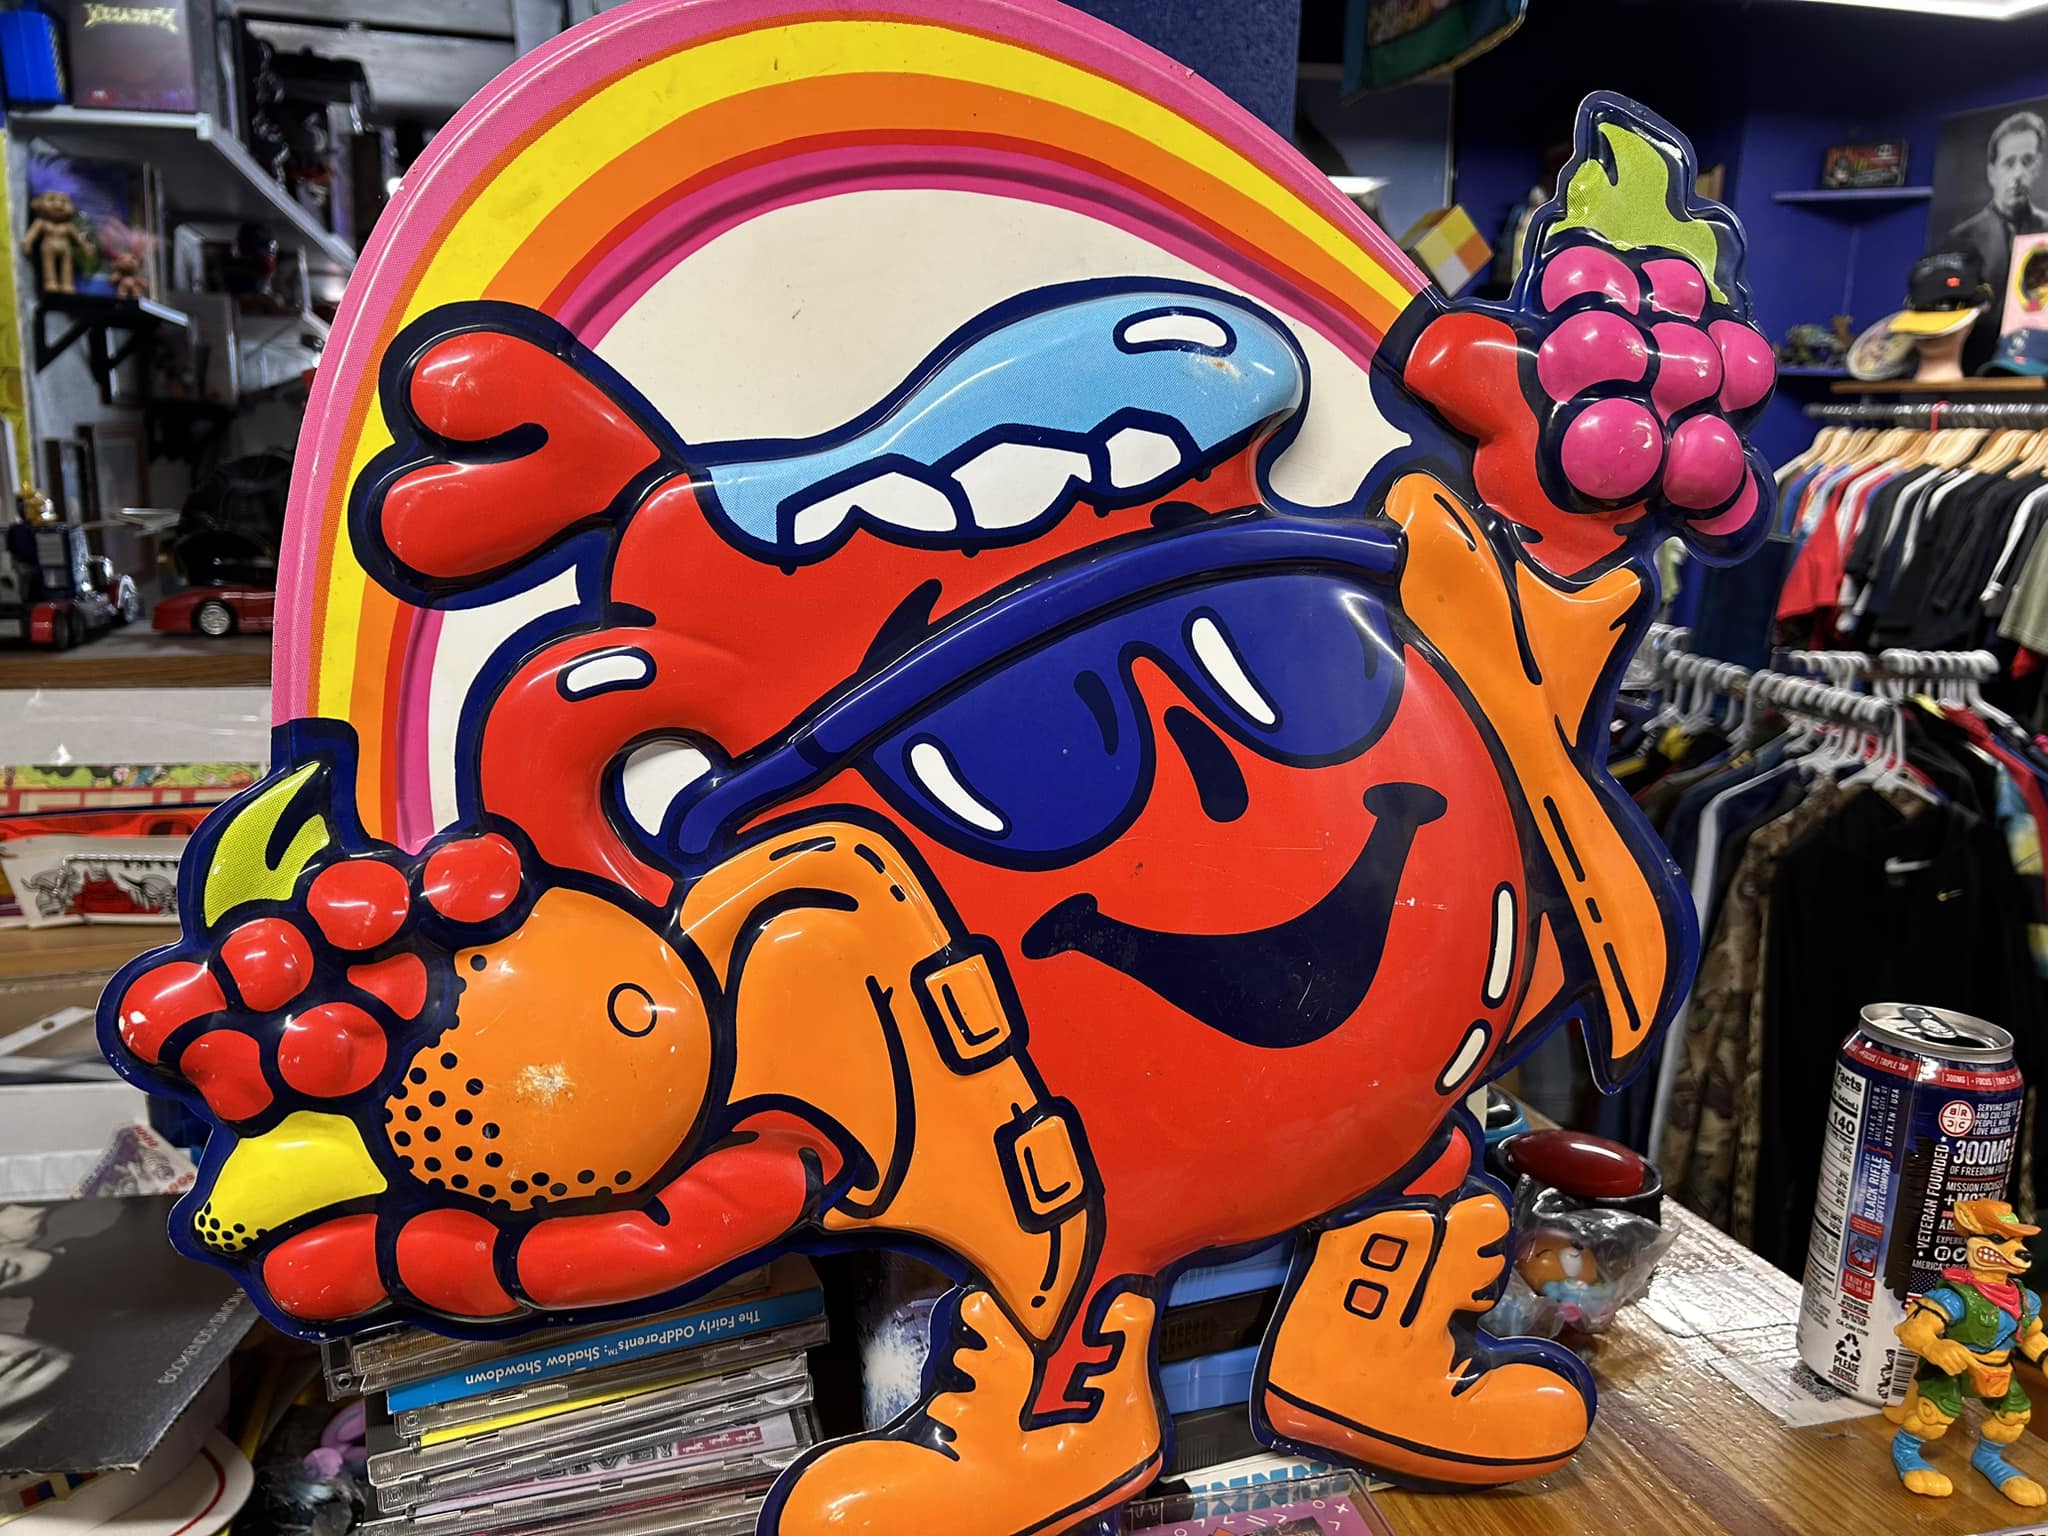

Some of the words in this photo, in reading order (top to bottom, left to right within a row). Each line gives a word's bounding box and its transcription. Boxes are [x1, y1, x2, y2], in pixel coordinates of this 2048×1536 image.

[1890, 1088, 1899, 1104] USA
[1833, 1111, 1856, 1135] 140
[1976, 1111, 1989, 1119] AND
[1973, 1127, 1988, 1135] LOVE
[1953, 1139, 2011, 1165] 300MG
[1868, 1155, 1883, 1185] RIFLE
[1879, 1158, 1891, 1195] COMPANY
[1926, 1144, 1949, 1196] FOUNDED
[1949, 1165, 1960, 1175] OF
[1960, 1166, 1994, 1176] FREEDOM
[1946, 1182, 1979, 1192] MISSION
[1864, 1186, 1878, 1220] BLACK
[1875, 1194, 1886, 1223] COFFEE
[1916, 1198, 1938, 1248] VETERAN
[699, 1315, 735, 1334] Fairly
[737, 1310, 760, 1323] The
[546, 1346, 600, 1366] Shadow
[1833, 1354, 1859, 1374] PLEASE
[465, 1359, 542, 1385] Showdown
[1832, 1365, 1858, 1382] RECYCLE
